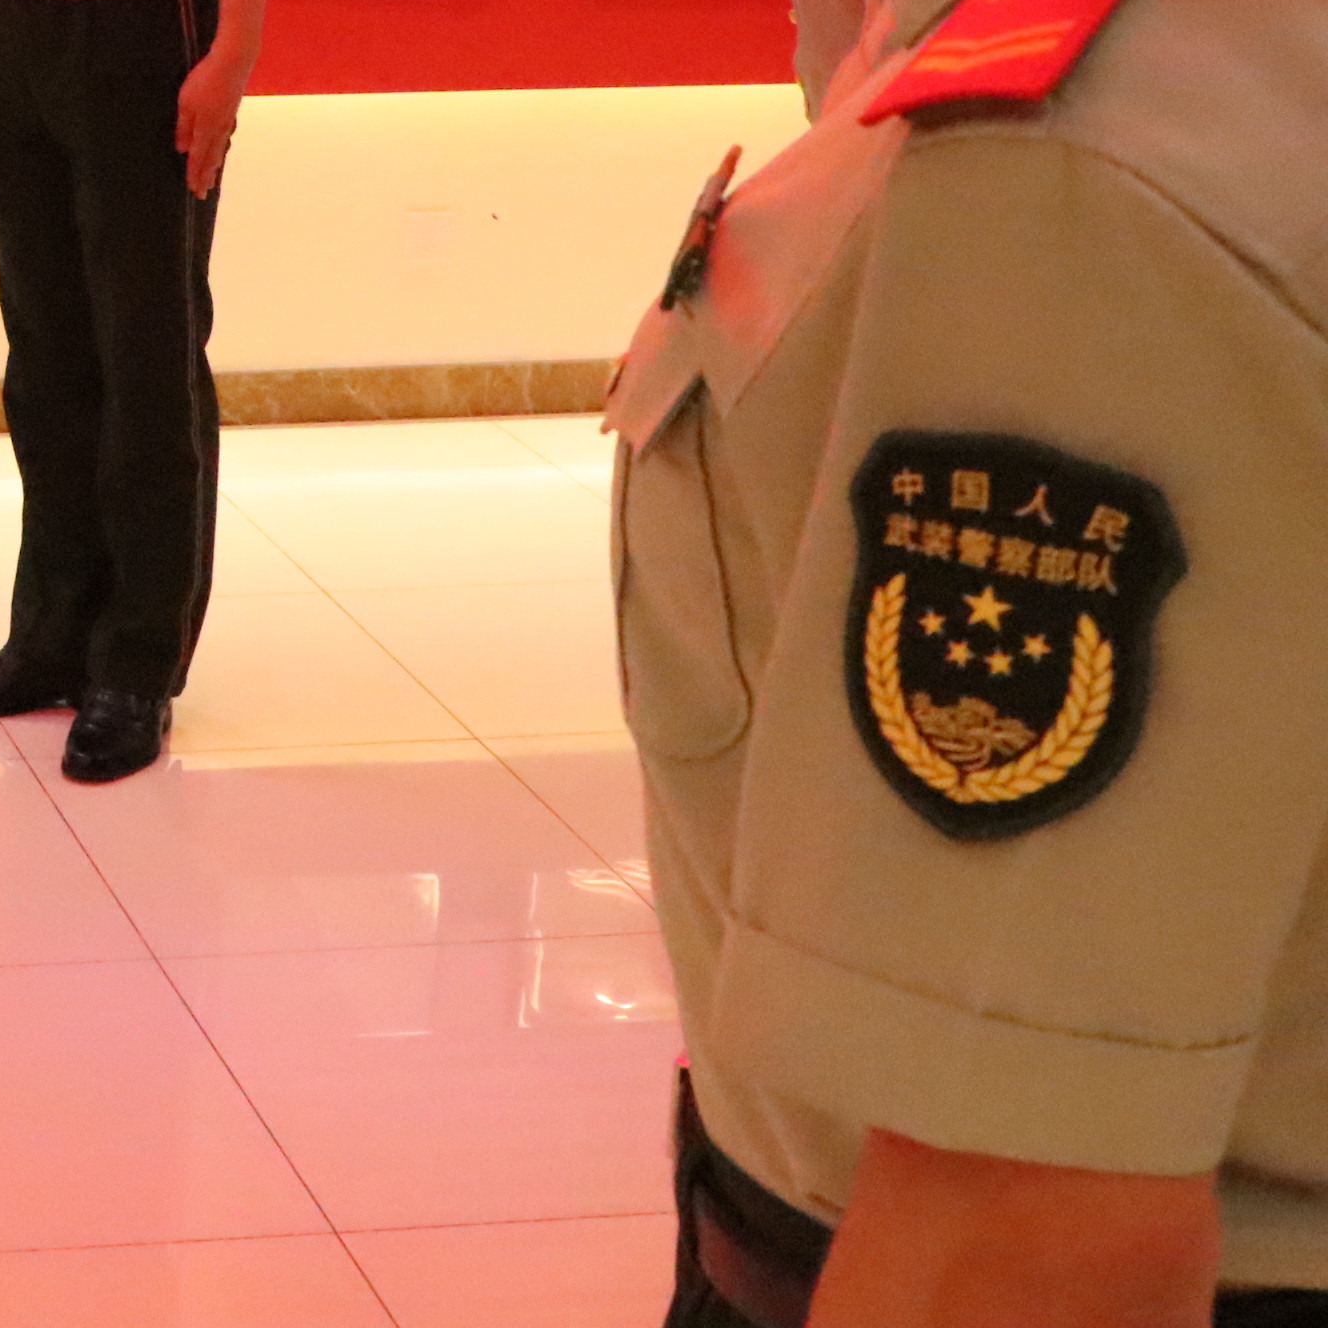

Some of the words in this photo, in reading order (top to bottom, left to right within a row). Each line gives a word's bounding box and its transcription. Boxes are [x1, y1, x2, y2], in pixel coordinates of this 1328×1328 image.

[891, 466, 1131, 552] 中国人民
[884, 512, 1118, 596] 武装警察部队
